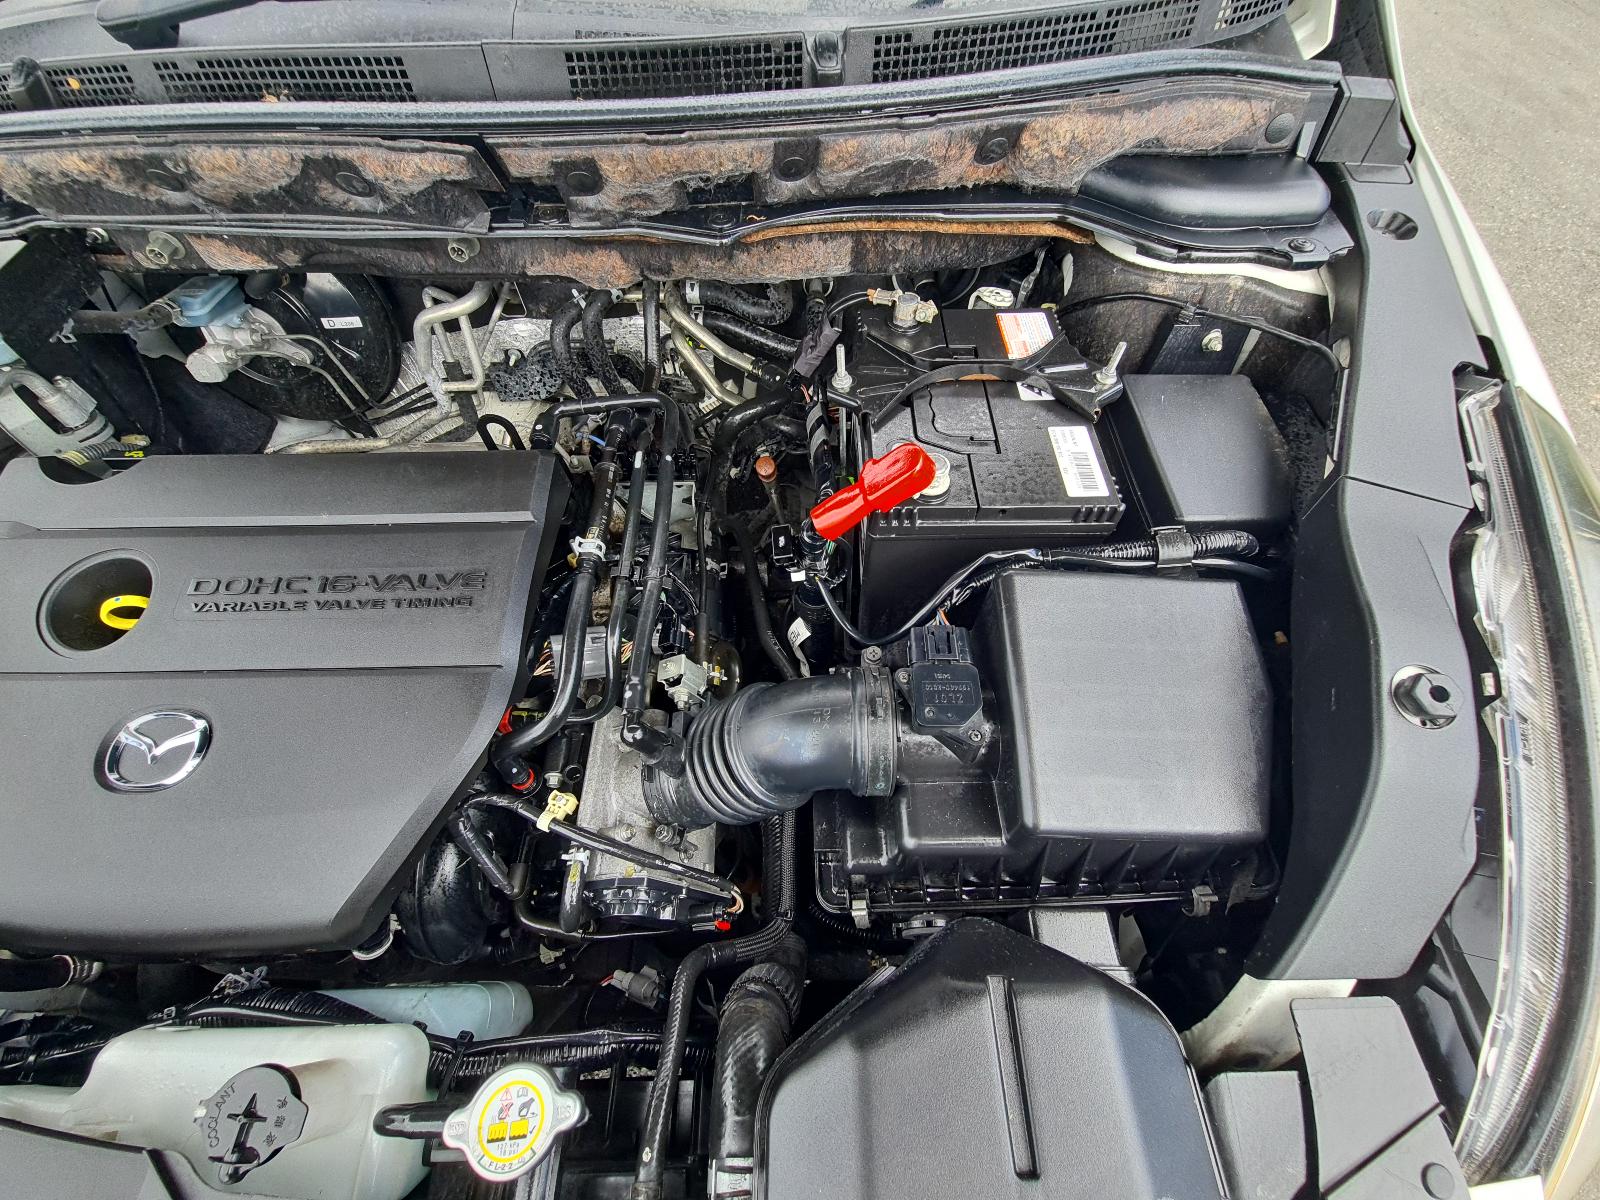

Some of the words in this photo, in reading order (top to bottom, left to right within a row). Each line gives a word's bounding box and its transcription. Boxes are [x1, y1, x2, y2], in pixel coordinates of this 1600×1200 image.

[186, 576, 312, 595] DOHC
[317, 571, 488, 593] 16-VALVE
[191, 600, 309, 613] VARIABLE
[313, 598, 386, 611] VALVE
[391, 595, 473, 609] TIMING
[207, 1082, 236, 1148] COOLANT
